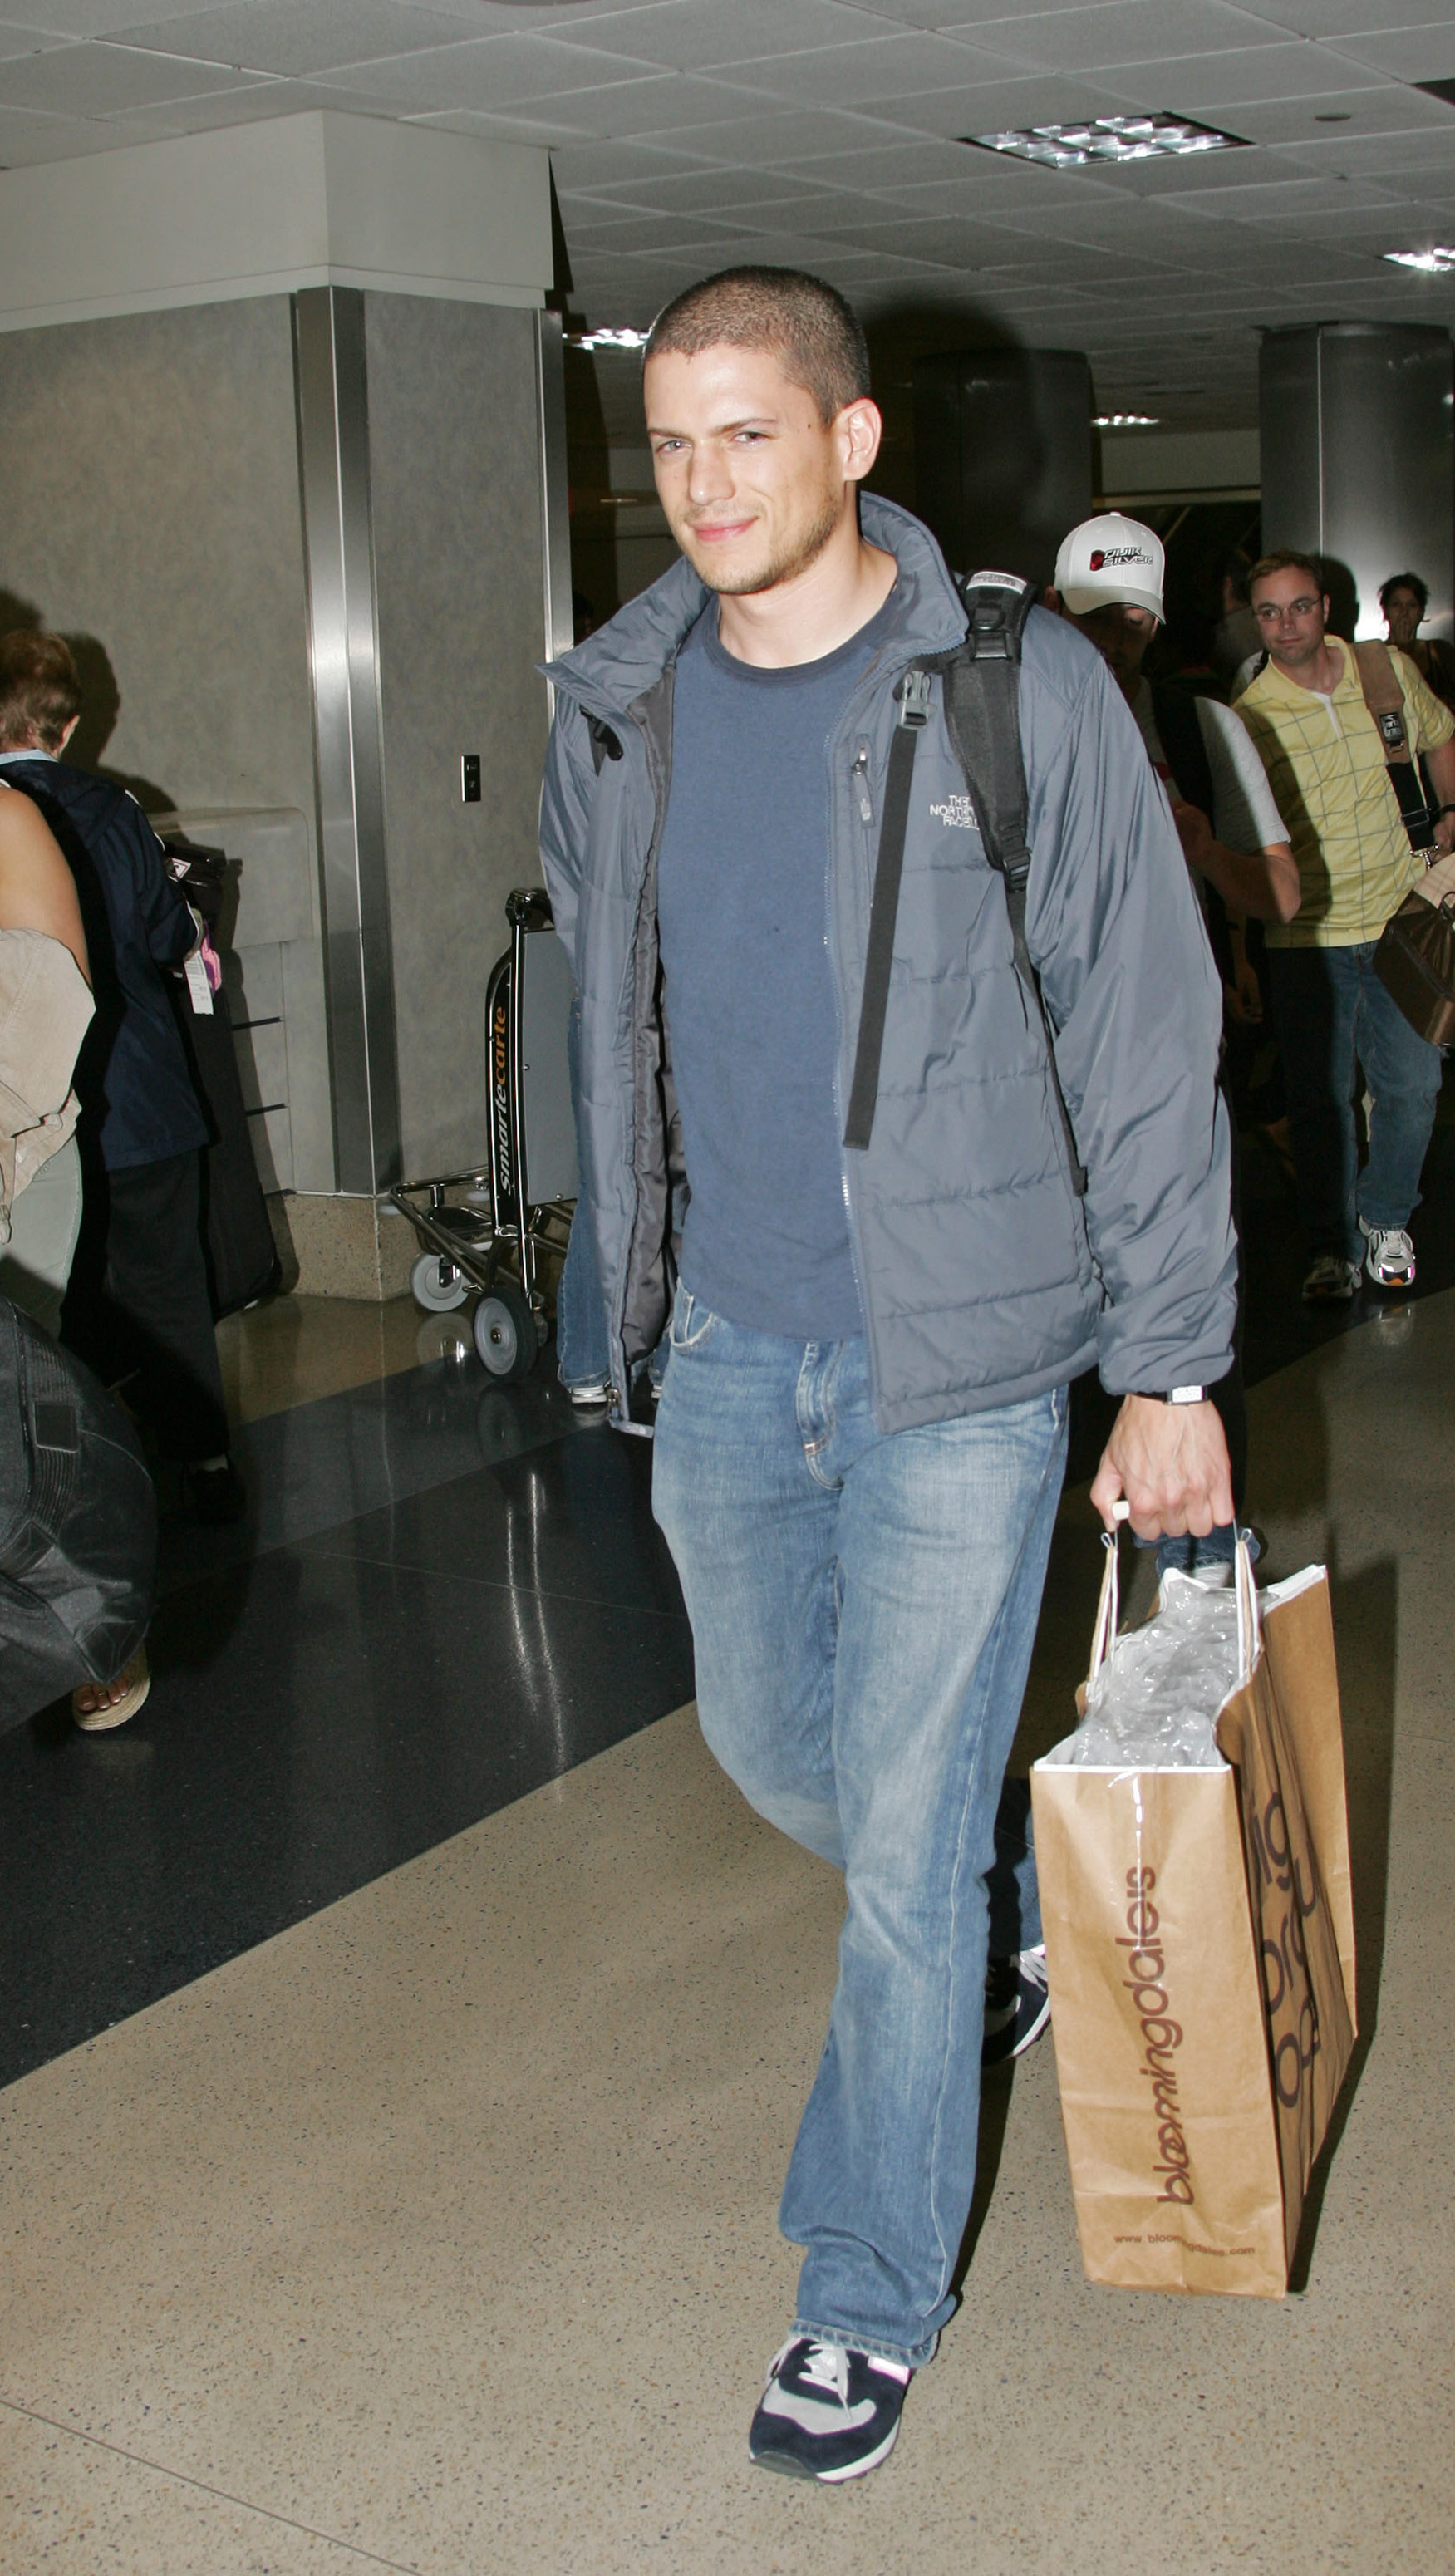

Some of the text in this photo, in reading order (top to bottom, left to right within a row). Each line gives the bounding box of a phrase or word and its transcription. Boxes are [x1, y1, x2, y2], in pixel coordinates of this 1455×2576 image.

[1103, 555, 1153, 568] SILVER
[949, 795, 968, 807] THE
[930, 804, 968, 817] NORTH
[943, 815, 970, 828] FACE
[1115, 1866, 1194, 2205] bloomingdale's
